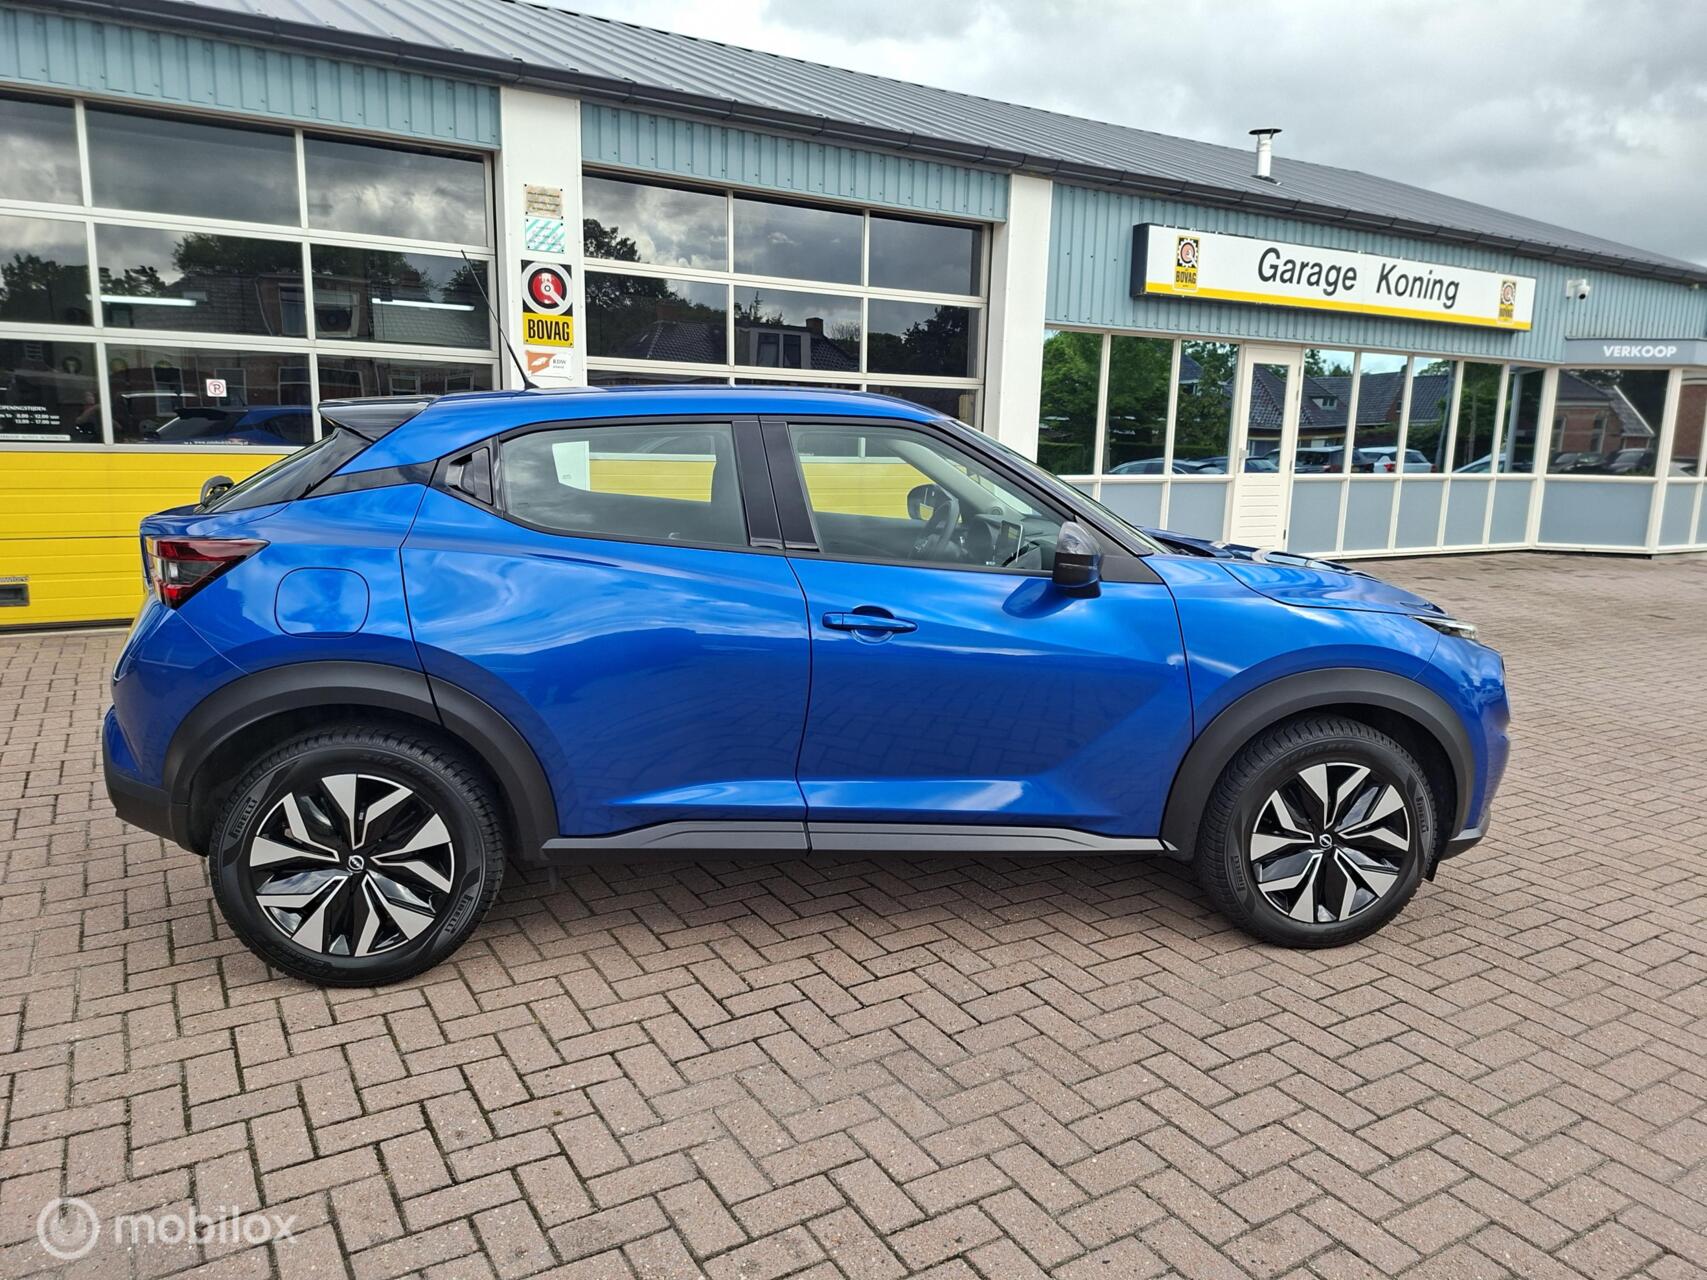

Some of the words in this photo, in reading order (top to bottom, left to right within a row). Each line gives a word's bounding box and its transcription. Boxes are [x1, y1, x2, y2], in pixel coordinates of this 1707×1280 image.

[1175, 270, 1197, 285] BOVAG
[1257, 246, 1358, 297] Garage
[1375, 263, 1460, 309] Koning
[527, 318, 570, 342] BOVAG
[1603, 345, 1678, 358] VERKOOP
